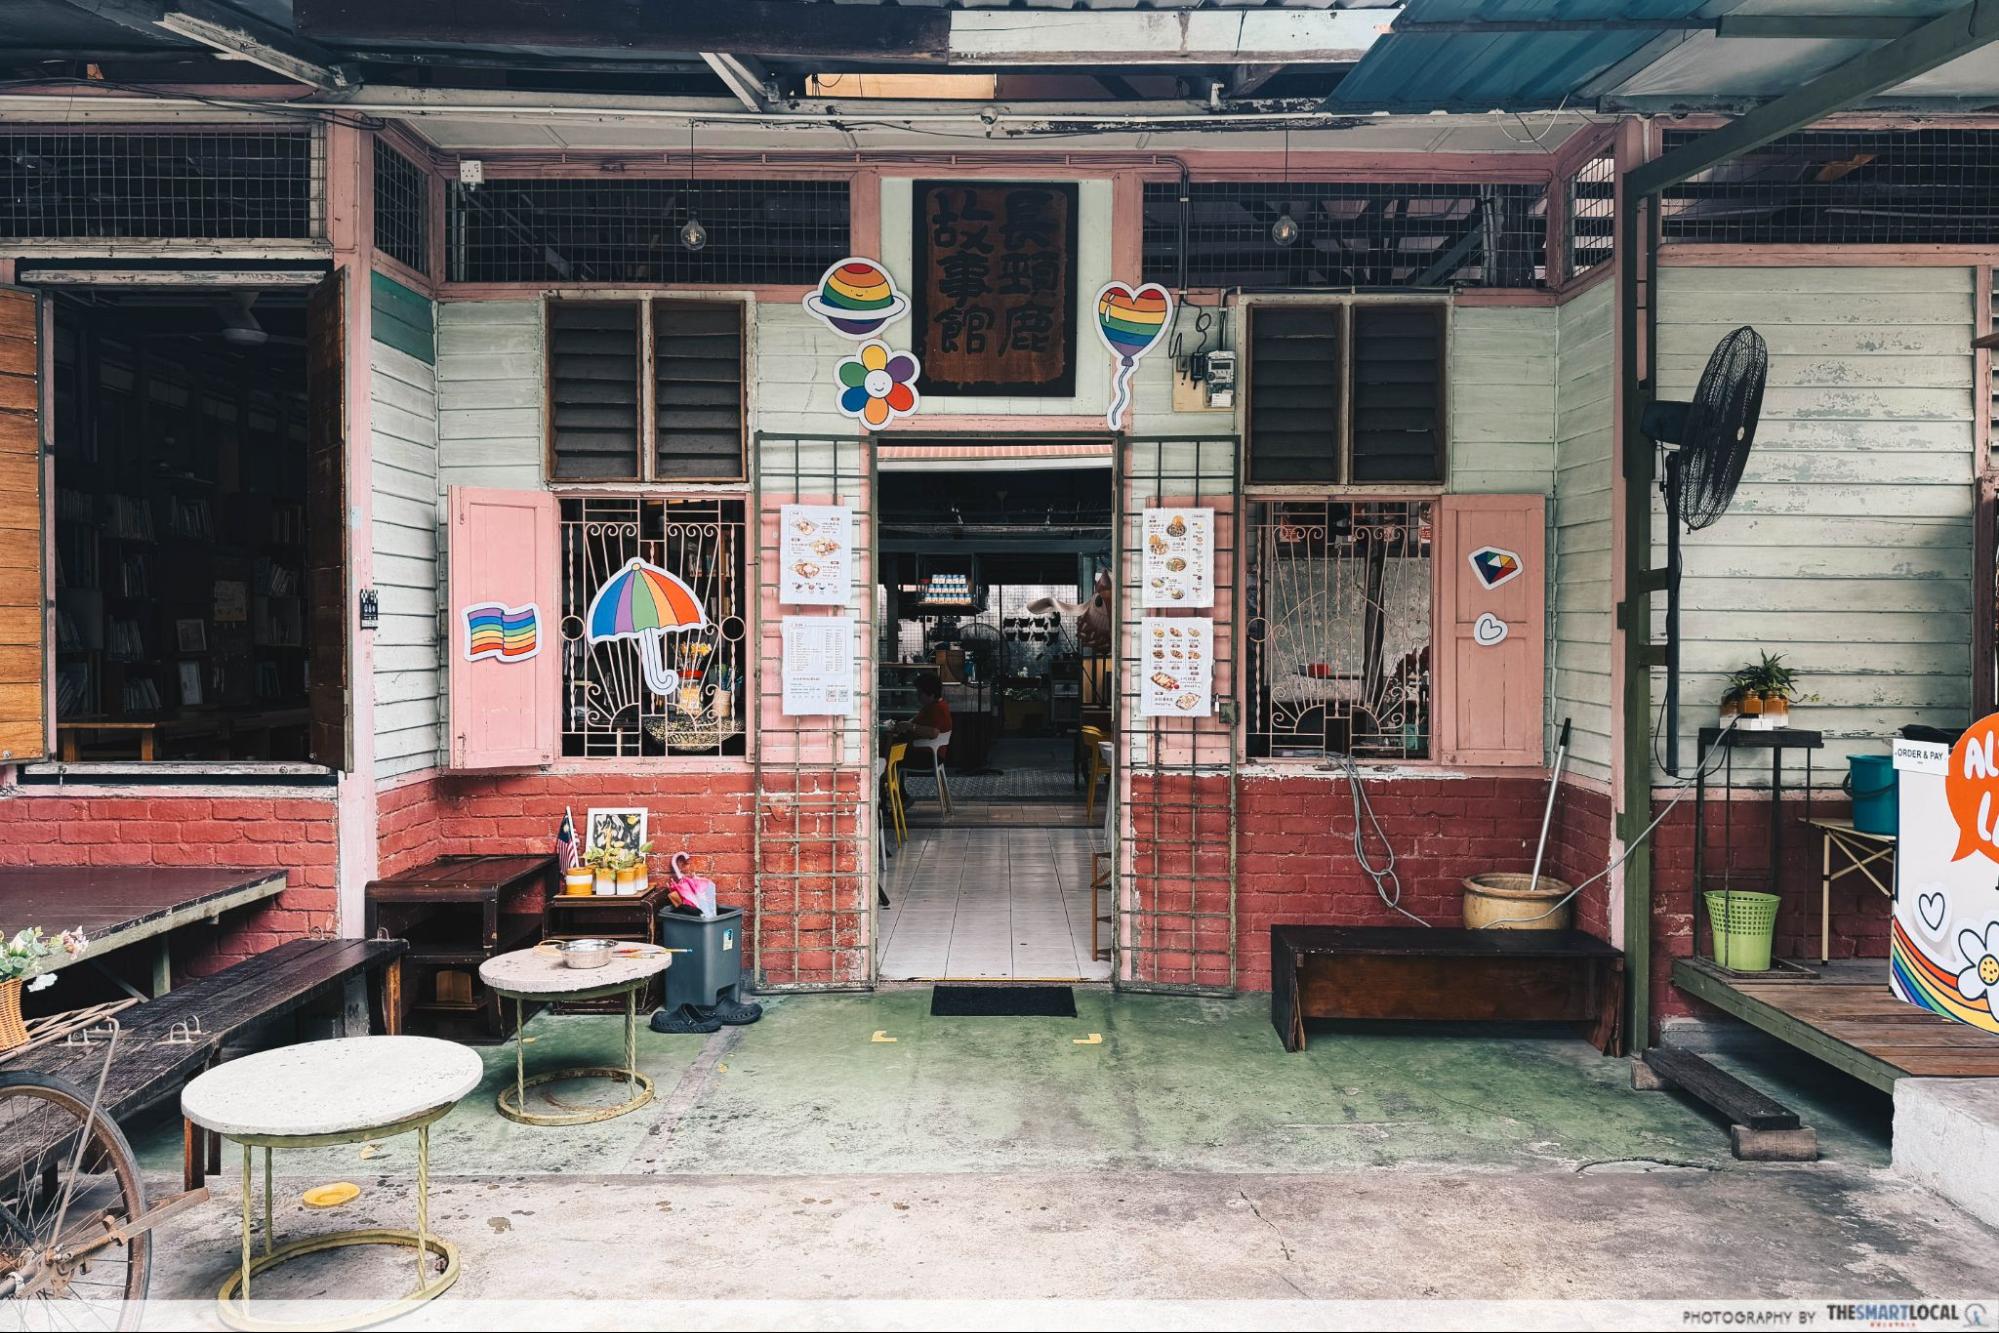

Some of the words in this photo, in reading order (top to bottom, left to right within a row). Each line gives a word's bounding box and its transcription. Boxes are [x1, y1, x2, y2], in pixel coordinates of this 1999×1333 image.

[932, 190, 995, 355] 故事館
[1897, 748, 1922, 759] ORDER
[1930, 751, 1944, 760] PAY
